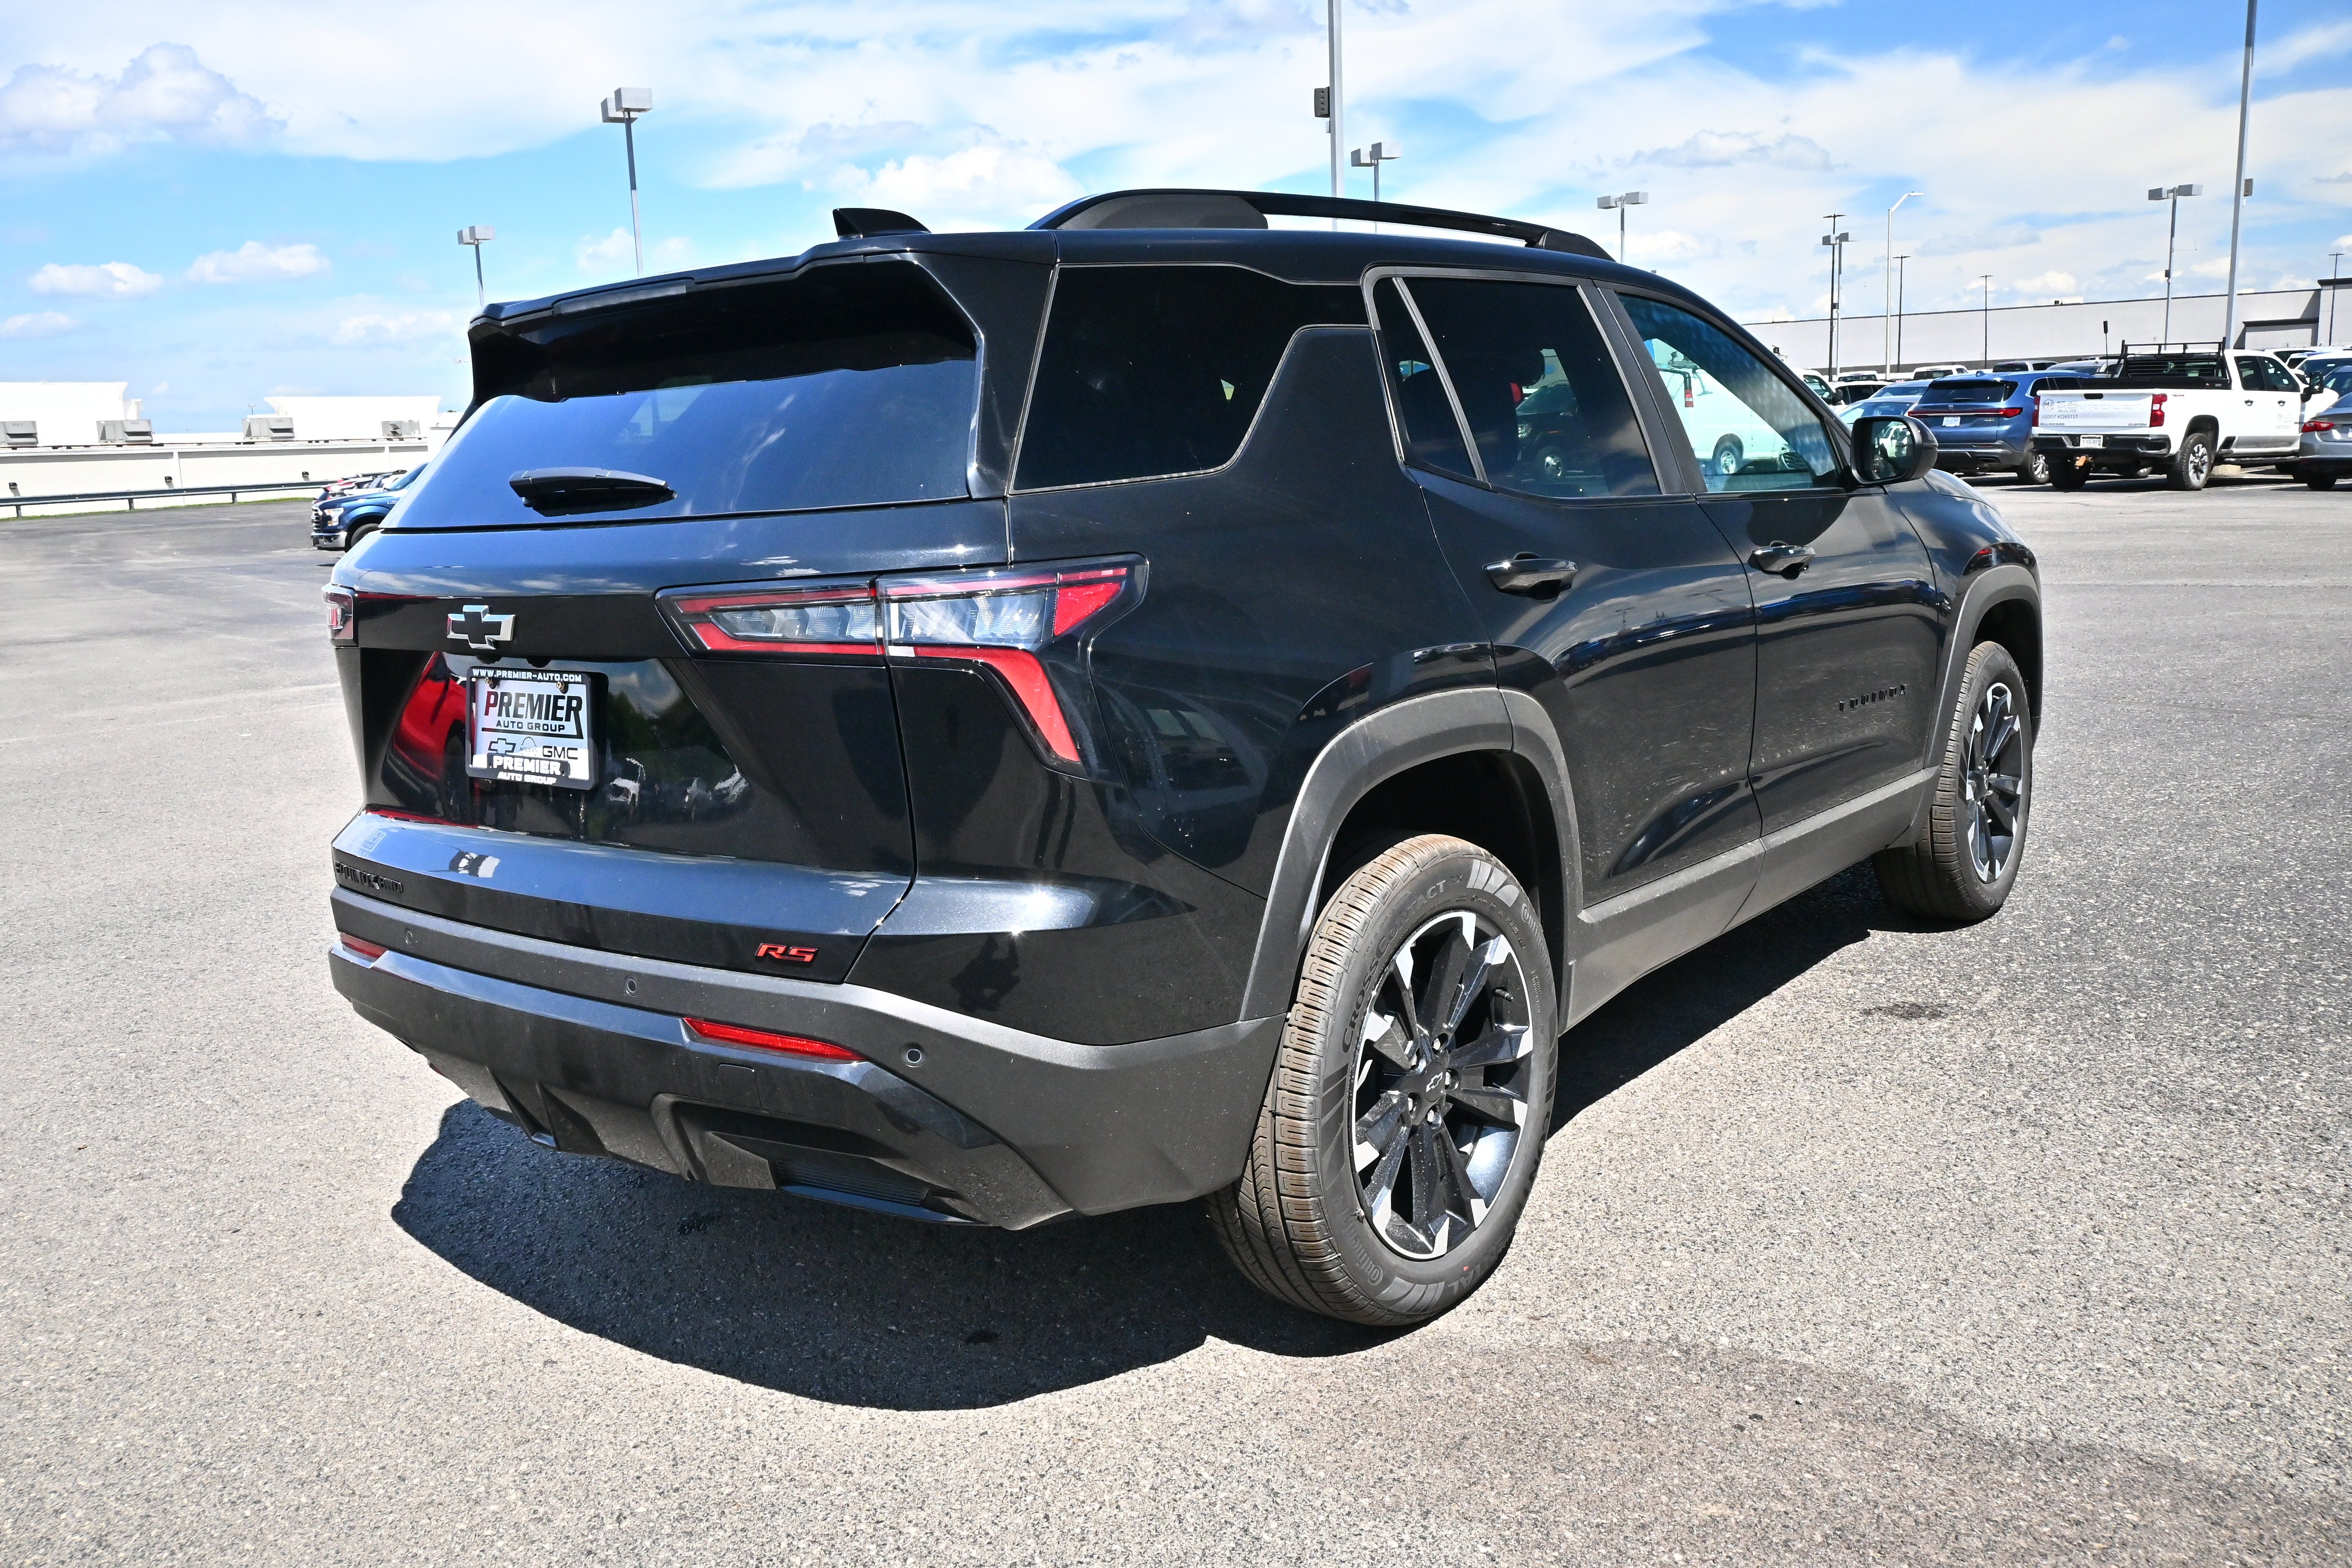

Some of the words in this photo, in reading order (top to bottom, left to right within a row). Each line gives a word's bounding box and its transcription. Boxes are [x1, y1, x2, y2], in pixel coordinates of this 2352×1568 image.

[472, 669, 582, 682] WWW.PREMIER-AUTO.COM
[484, 691, 583, 725] PREMIER
[496, 720, 523, 730] AUTO
[527, 722, 565, 732] GROUP
[542, 746, 578, 760] GMC
[493, 755, 561, 776] PREMIER
[498, 771, 523, 781] AUTO
[524, 773, 557, 785] GROUP
[754, 942, 818, 962] RS
